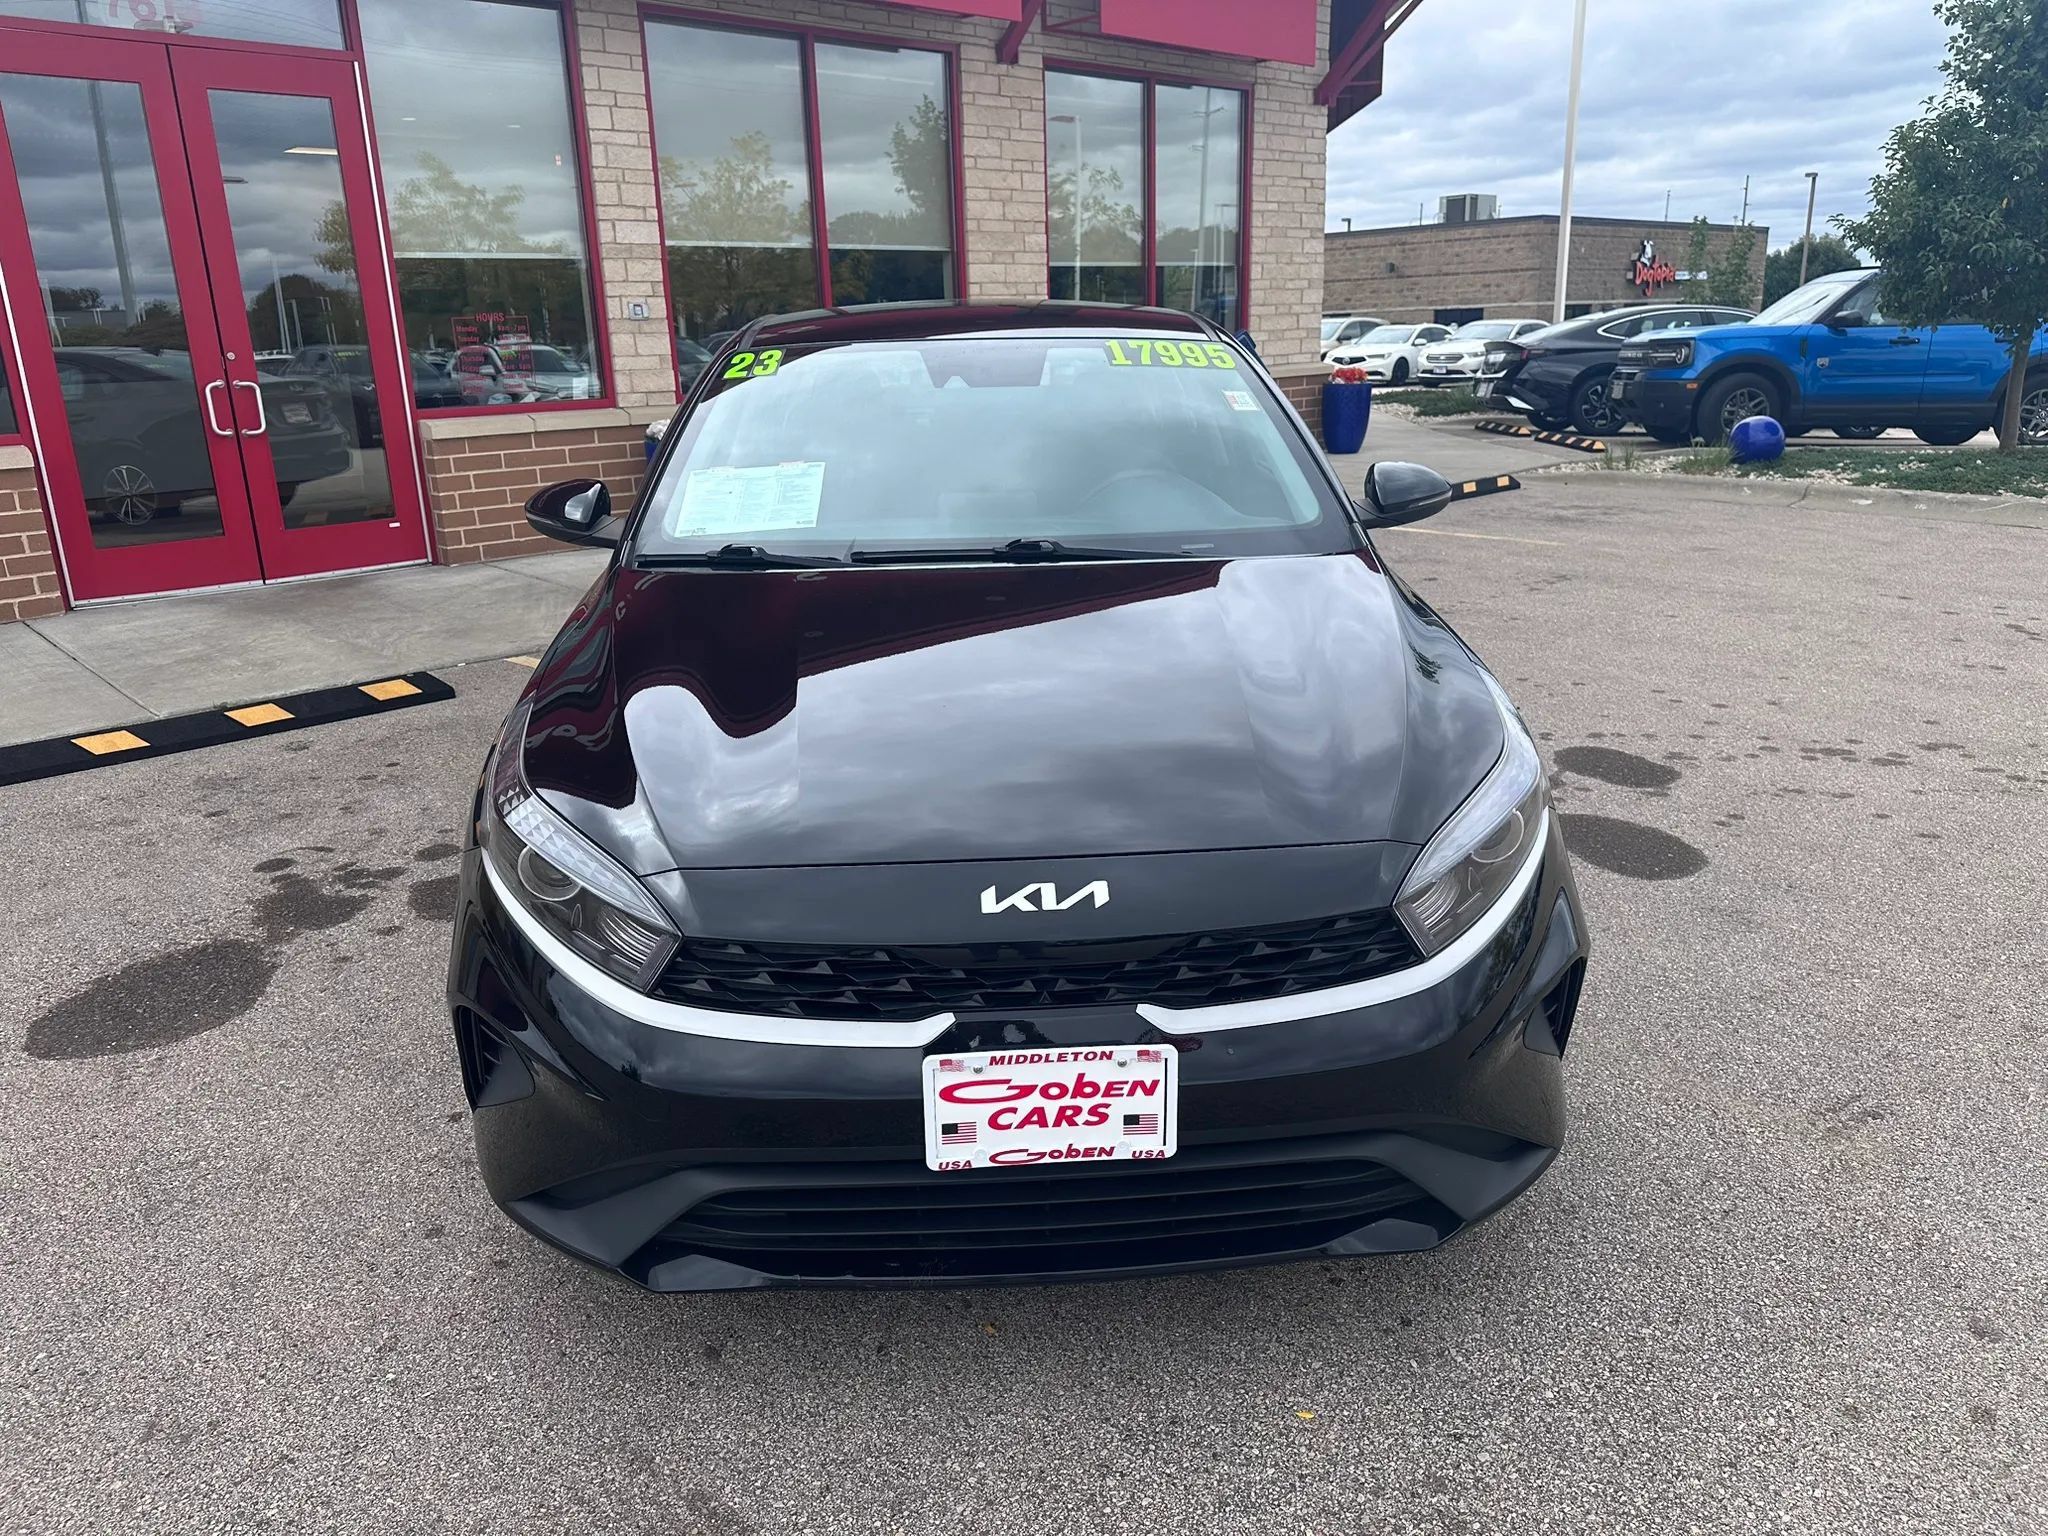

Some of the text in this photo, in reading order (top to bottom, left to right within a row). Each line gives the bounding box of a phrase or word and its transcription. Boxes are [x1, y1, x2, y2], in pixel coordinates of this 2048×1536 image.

[476, 312, 505, 322] HOURS
[723, 349, 783, 380] 23
[1105, 339, 1236, 369] 17995
[980, 880, 1110, 915] KIA
[989, 1050, 1114, 1066] MIDDLETON
[987, 1103, 1112, 1131] CARS
[938, 1159, 973, 1170] USA
[1131, 1149, 1167, 1159] USA
